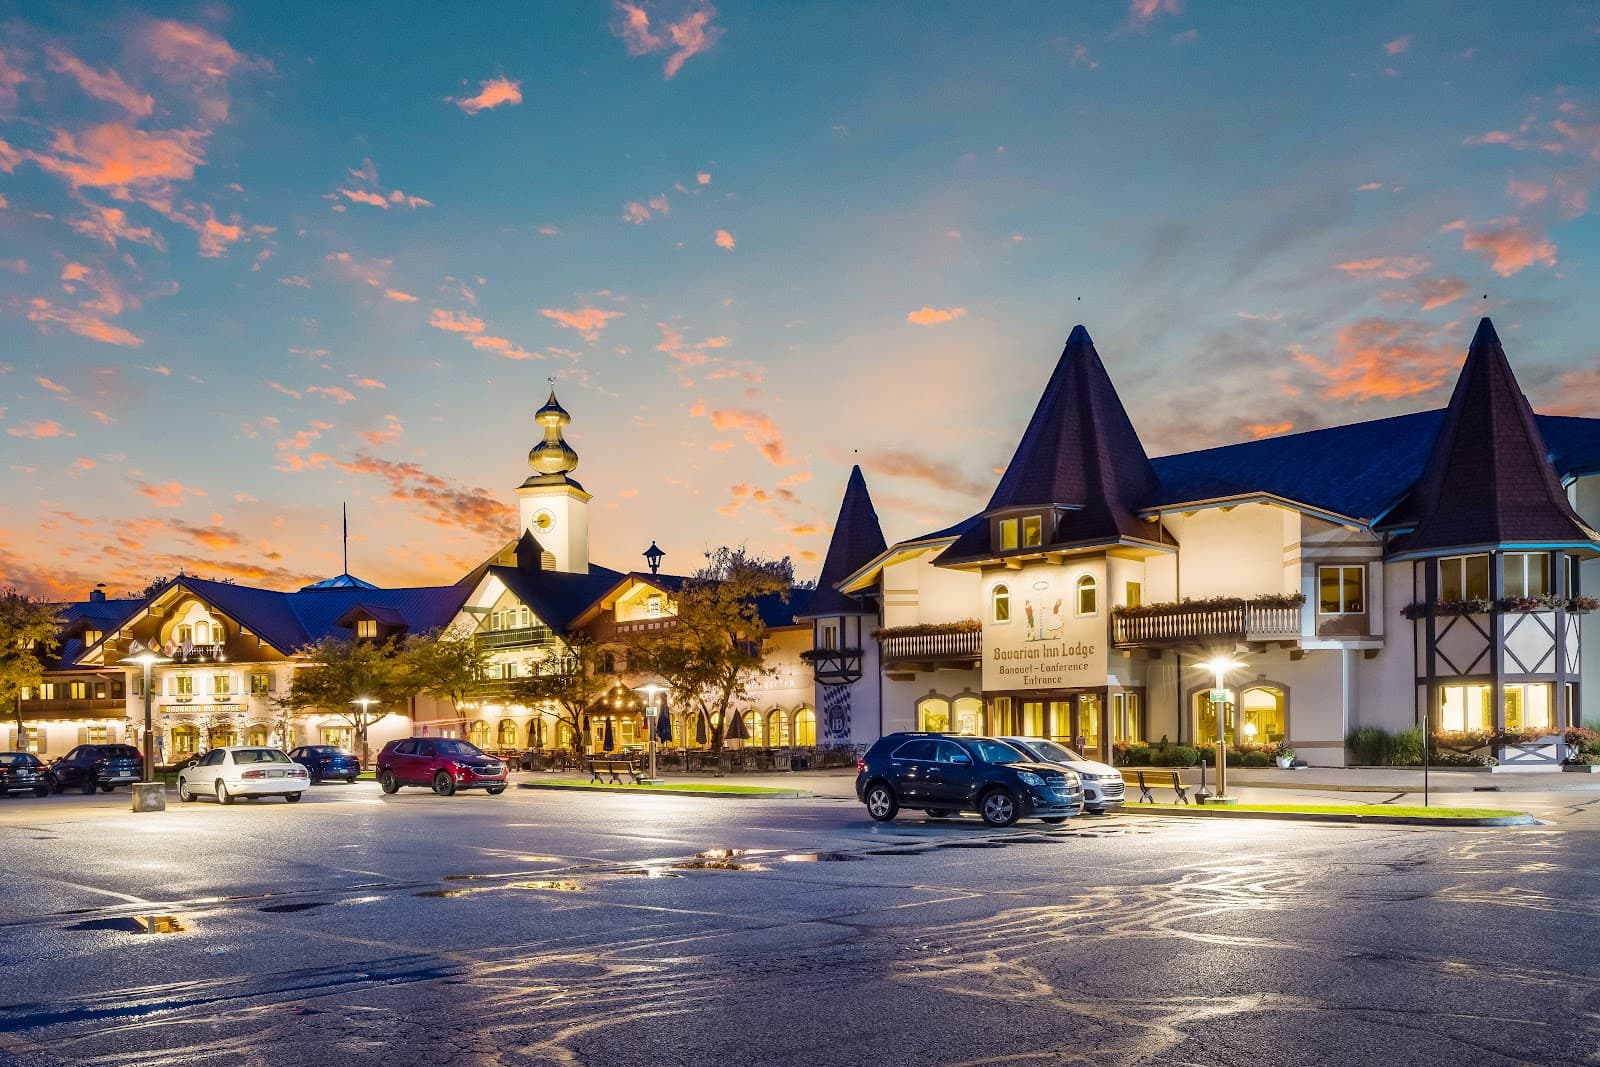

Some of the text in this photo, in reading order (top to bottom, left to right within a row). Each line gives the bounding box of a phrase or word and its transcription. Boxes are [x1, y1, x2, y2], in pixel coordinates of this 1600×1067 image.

[993, 642, 1095, 661] Bavarian Inn Lodge
[999, 665, 1033, 675] Banquet
[1040, 662, 1089, 673] Conference
[1023, 675, 1062, 685] Entrance
[217, 704, 241, 712] LODGE
